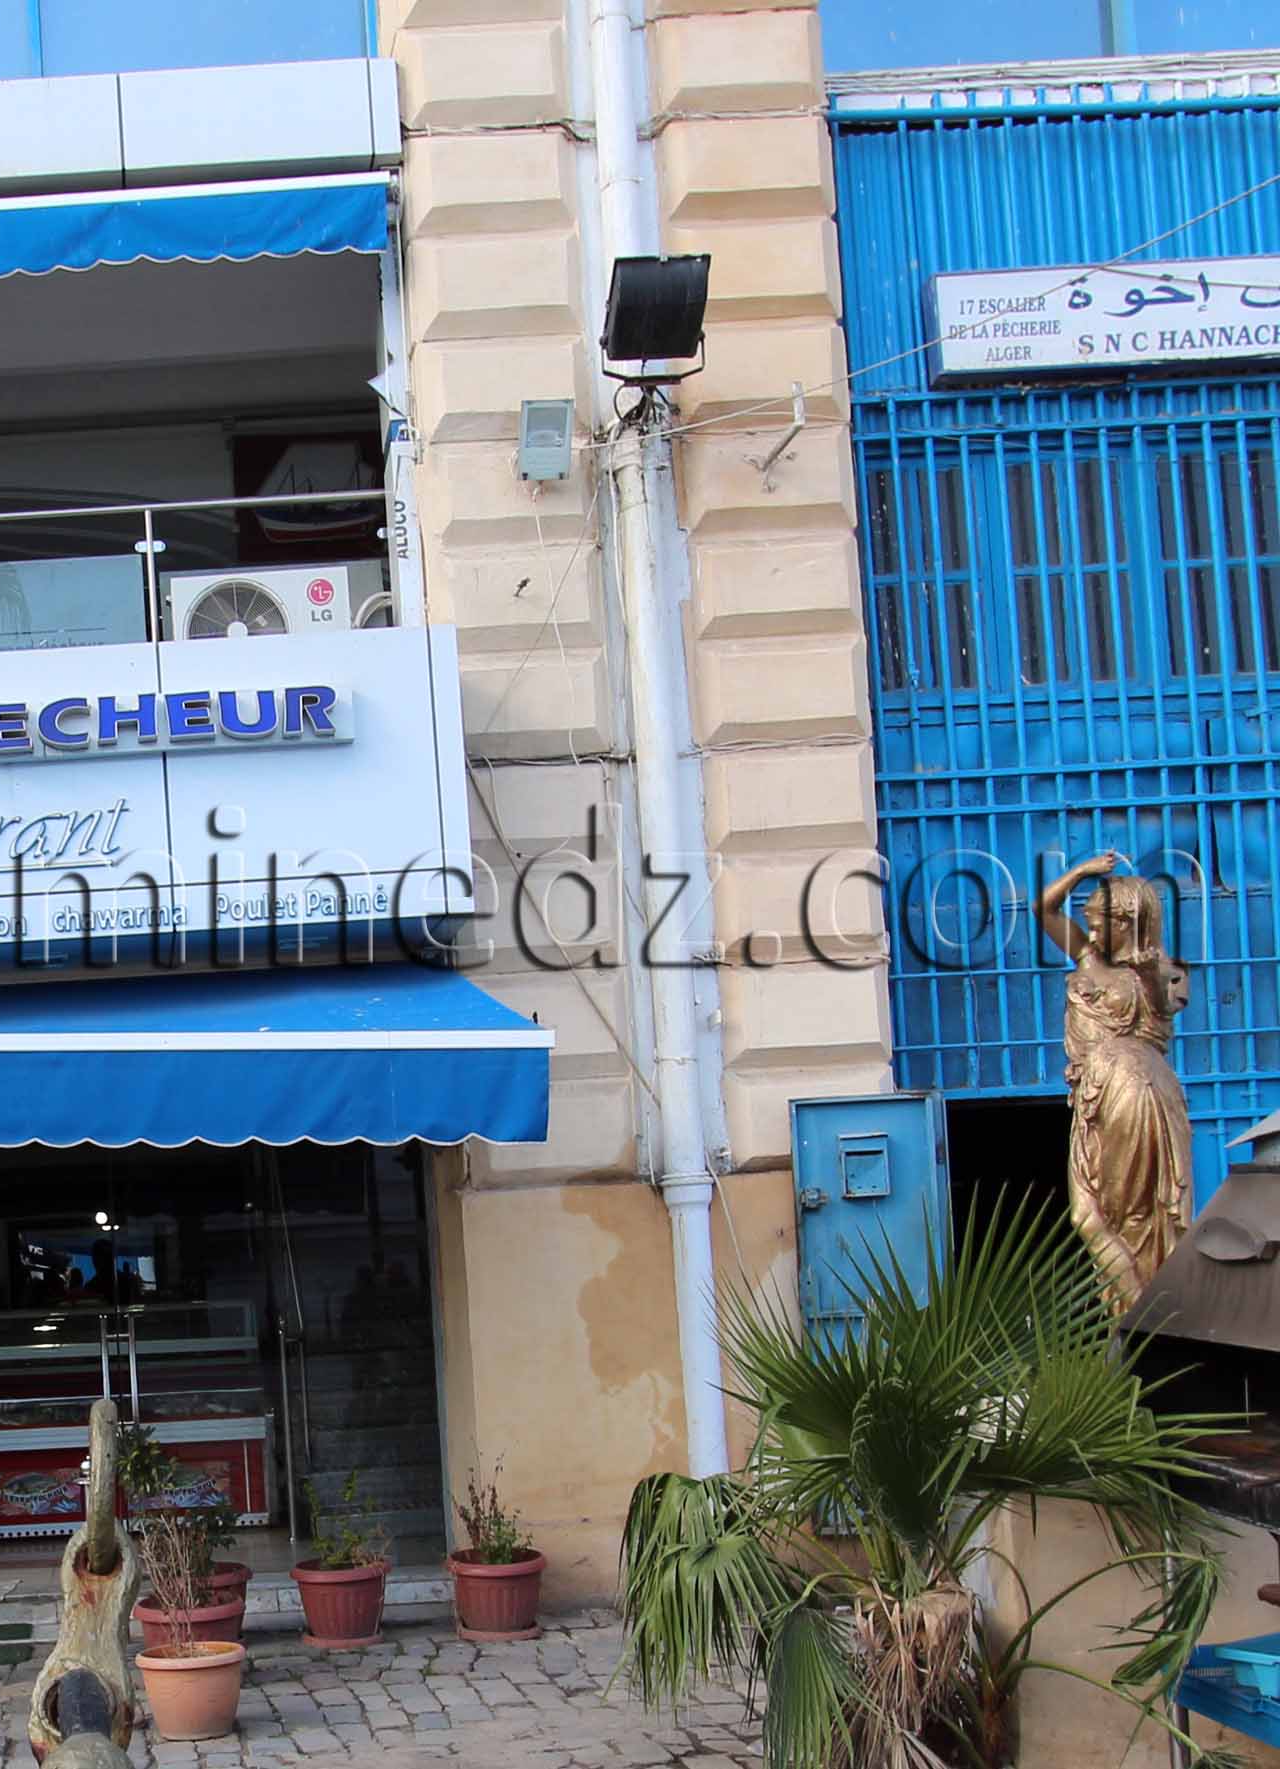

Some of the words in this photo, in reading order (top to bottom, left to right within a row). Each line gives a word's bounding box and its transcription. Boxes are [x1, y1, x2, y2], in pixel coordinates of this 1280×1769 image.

[960, 299, 975, 315] 17
[978, 296, 1046, 314] ESCALIER
[949, 324, 967, 340] DE
[971, 325, 989, 339] LA
[986, 345, 1032, 361] ALGER
[393, 500, 409, 560] ALUCO
[311, 608, 333, 622] LG
[52, 902, 188, 934] chawarma
[215, 893, 297, 923] Poulet
[304, 883, 389, 917] Panné
